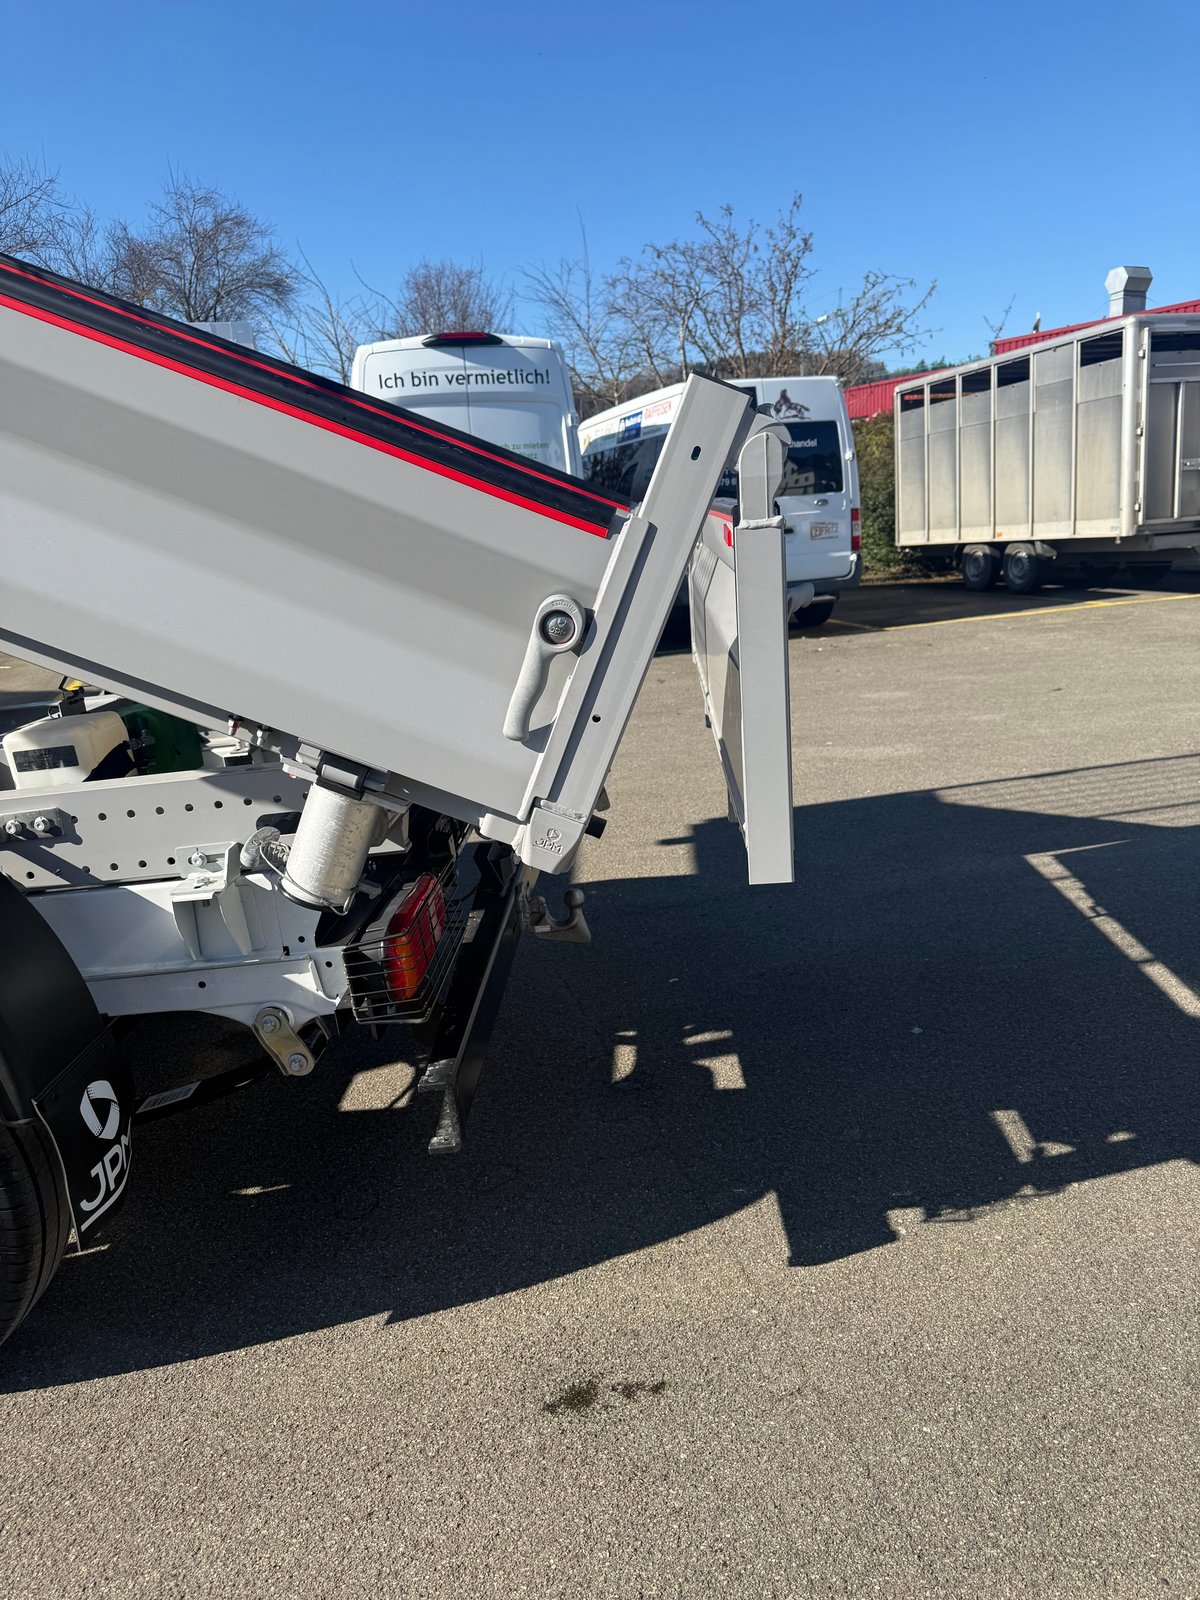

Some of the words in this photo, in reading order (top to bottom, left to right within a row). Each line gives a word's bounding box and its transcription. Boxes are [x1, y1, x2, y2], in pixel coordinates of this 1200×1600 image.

[378, 373, 405, 389] Ich
[411, 371, 439, 388] bin
[445, 368, 550, 386] vermietlich!
[522, 442, 549, 450] mieten
[788, 438, 818, 448] handel
[533, 838, 563, 854] JPM
[80, 1116, 132, 1211] JPM
